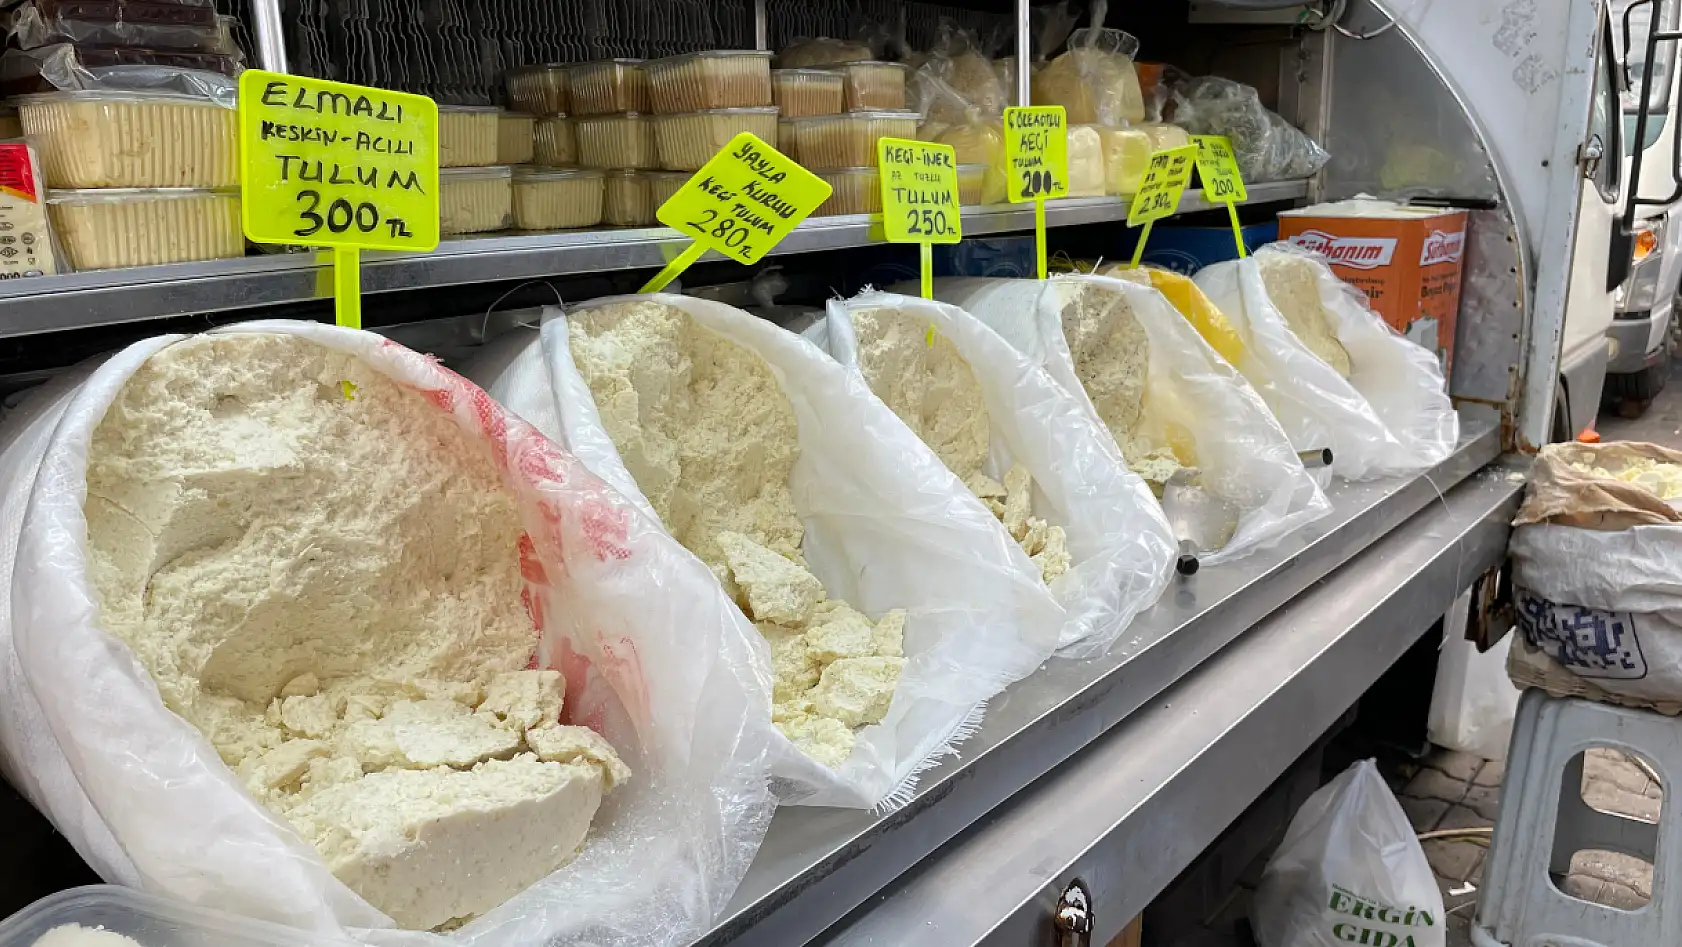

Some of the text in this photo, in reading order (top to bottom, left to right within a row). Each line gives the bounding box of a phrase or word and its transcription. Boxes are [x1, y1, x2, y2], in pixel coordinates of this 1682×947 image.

[261, 82, 402, 124] ELMALI
[275, 155, 425, 195] TULUM
[732, 142, 787, 184] YAYLA
[891, 188, 955, 208] TULUM
[1021, 170, 1052, 198] 200
[1213, 178, 1234, 196] 200
[293, 190, 413, 238] 300 TL
[686, 209, 749, 248] 280
[731, 203, 775, 235] TULUM
[907, 209, 956, 235] 250 TL
[1329, 891, 1434, 926] ERGİN
